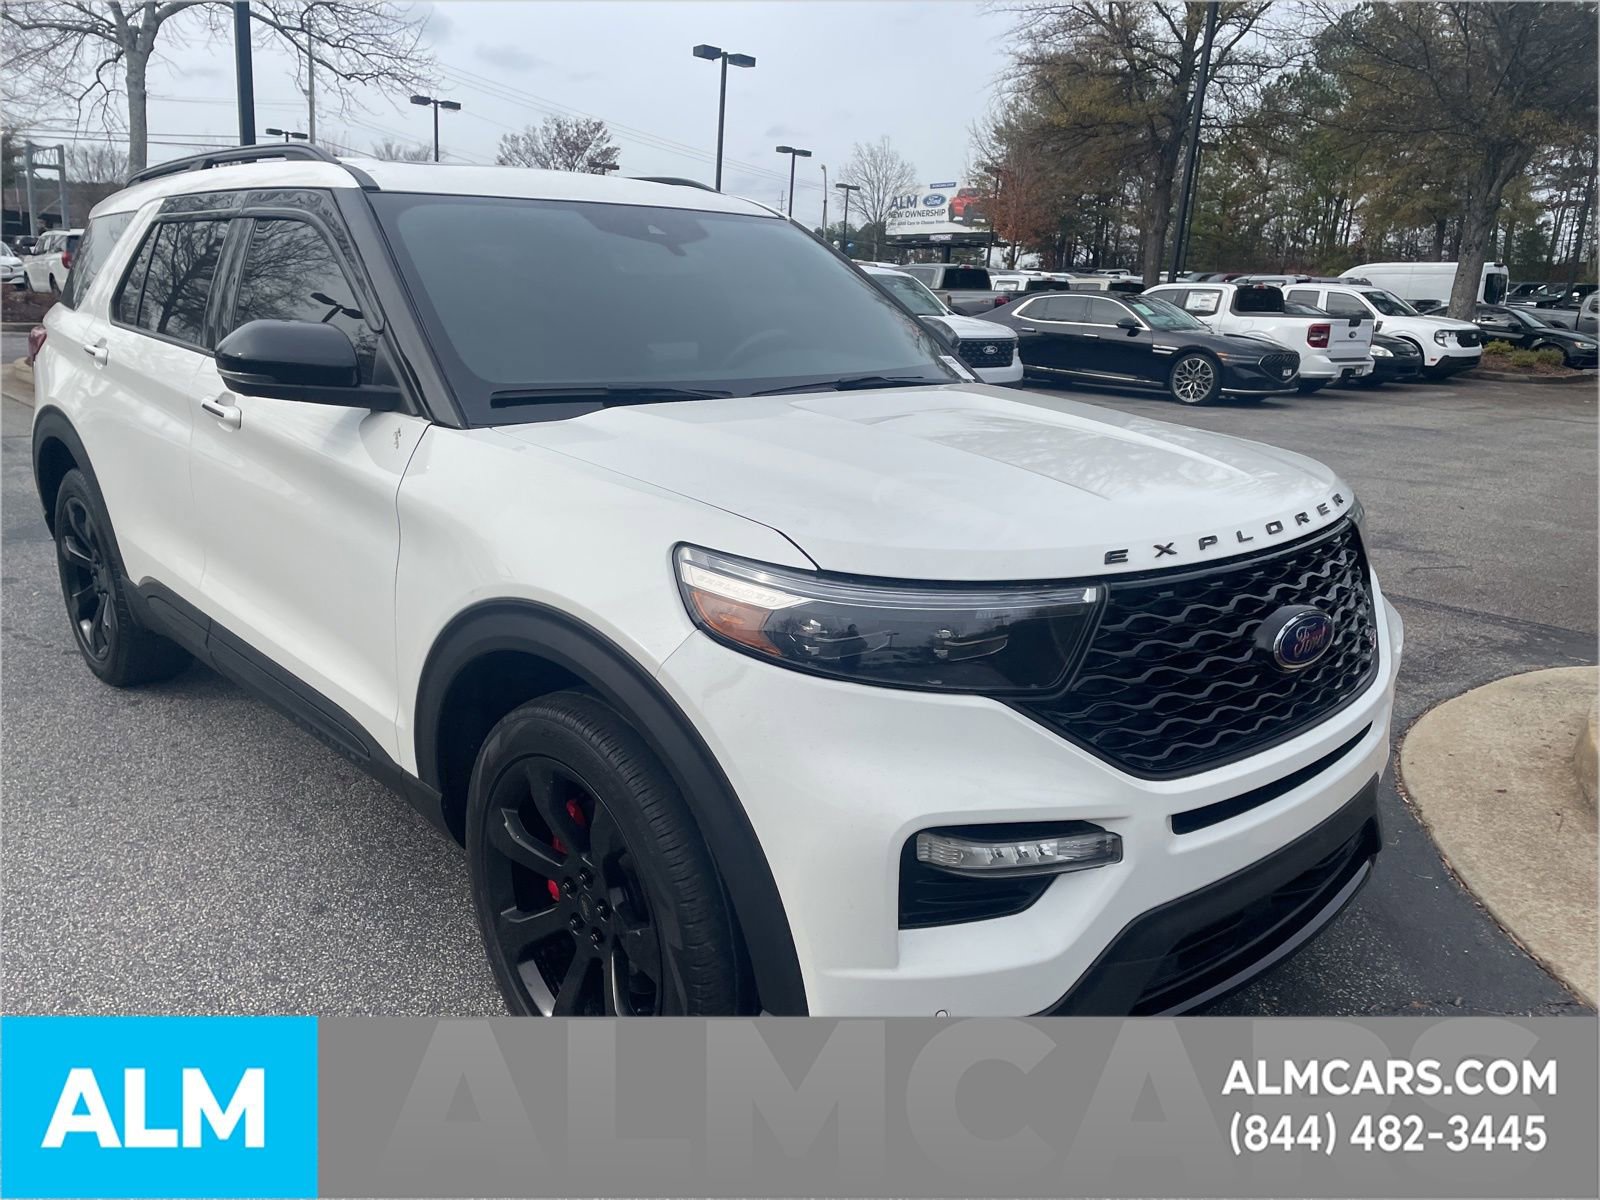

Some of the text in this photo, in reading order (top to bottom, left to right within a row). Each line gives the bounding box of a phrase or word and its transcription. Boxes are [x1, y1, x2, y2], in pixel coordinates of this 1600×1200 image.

[891, 195, 917, 209] ALM
[905, 209, 945, 218] OWNERSHIP
[1104, 493, 1344, 565] EXPLORER
[1293, 622, 1328, 658] Ford
